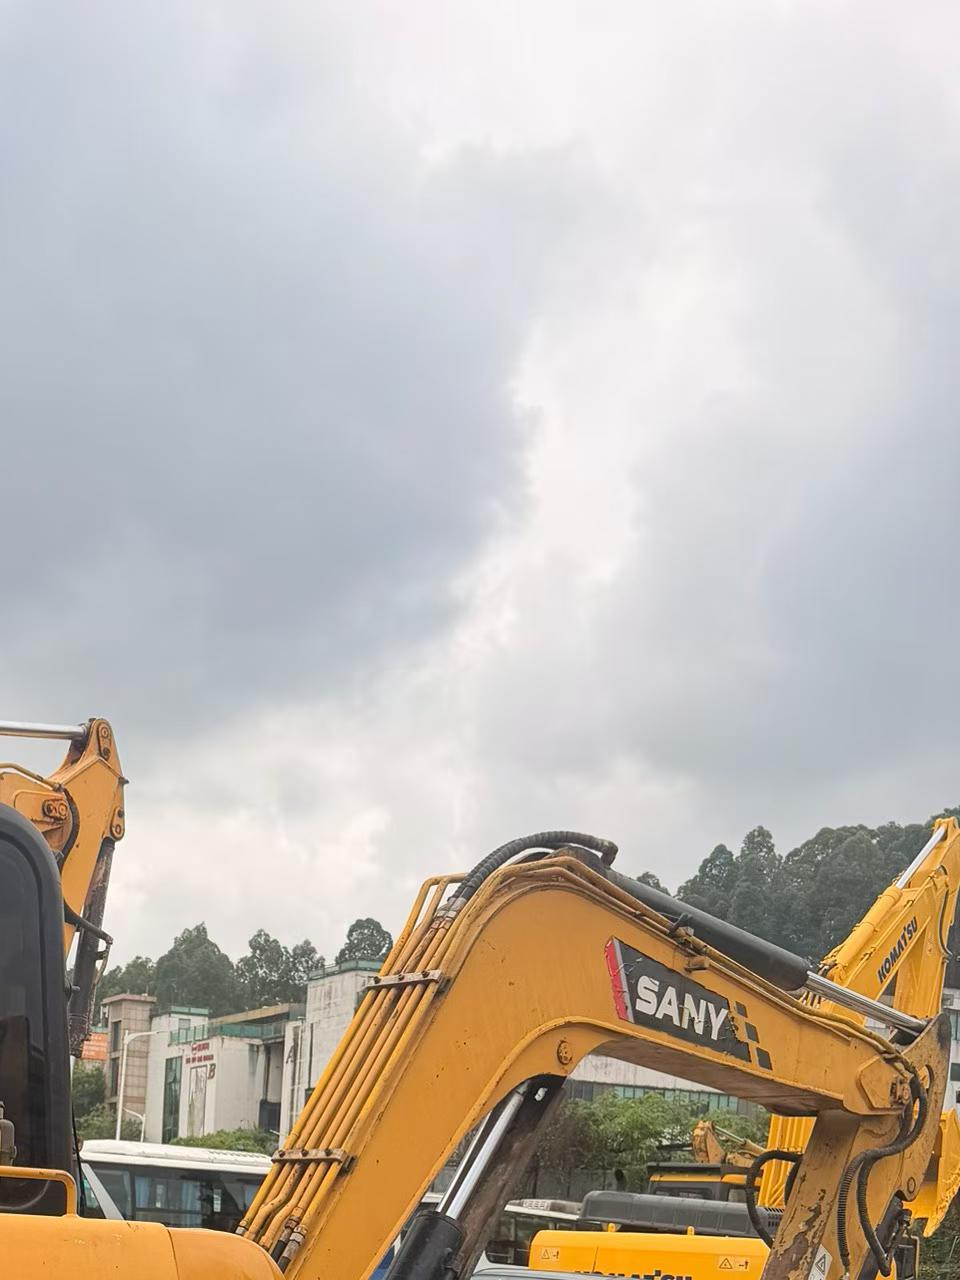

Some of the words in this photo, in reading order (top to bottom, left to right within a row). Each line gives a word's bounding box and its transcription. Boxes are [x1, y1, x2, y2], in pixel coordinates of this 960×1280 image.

[877, 916, 918, 985] KOMATSU
[635, 975, 729, 1040] SANY
[207, 1063, 216, 1080] B
